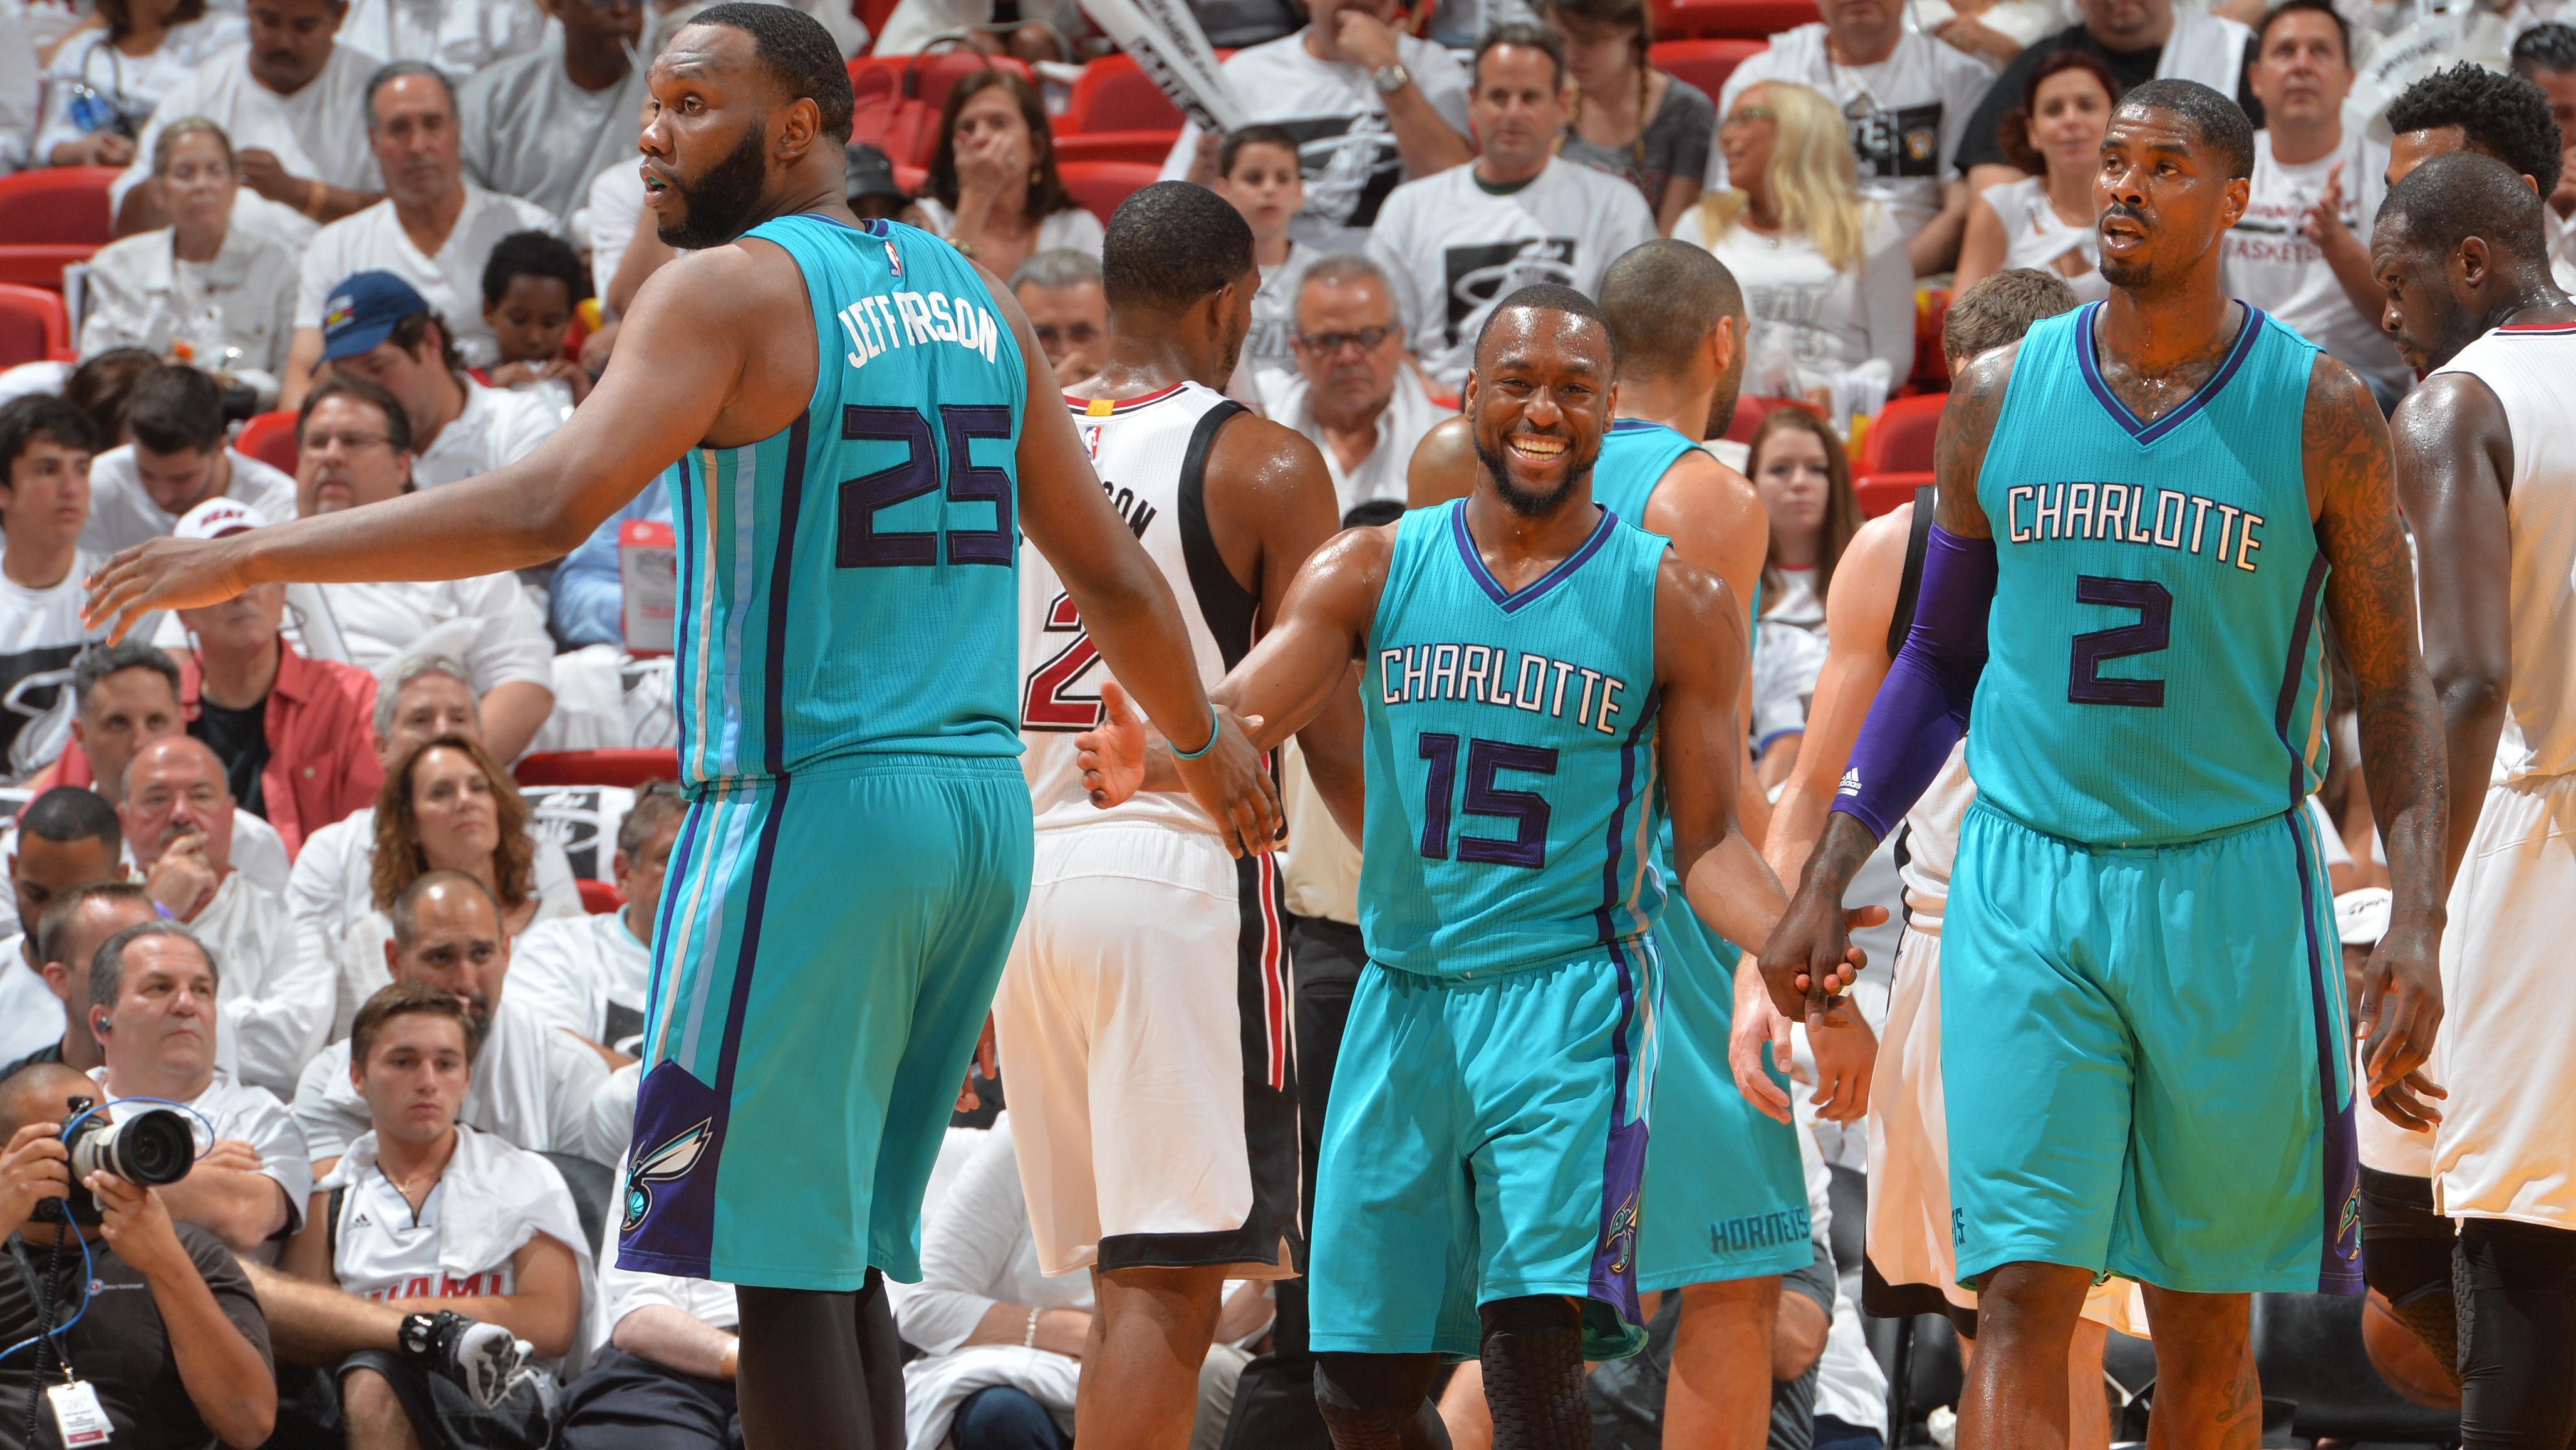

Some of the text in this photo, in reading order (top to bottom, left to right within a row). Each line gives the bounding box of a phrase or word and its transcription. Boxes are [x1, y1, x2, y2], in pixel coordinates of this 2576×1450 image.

[835, 403, 1014, 568] 25
[2007, 481, 2265, 573] CHARLOTTE
[1379, 643, 1627, 736] CHARLOTTE
[2067, 574, 2173, 707] 2
[1418, 731, 1559, 869] 15
